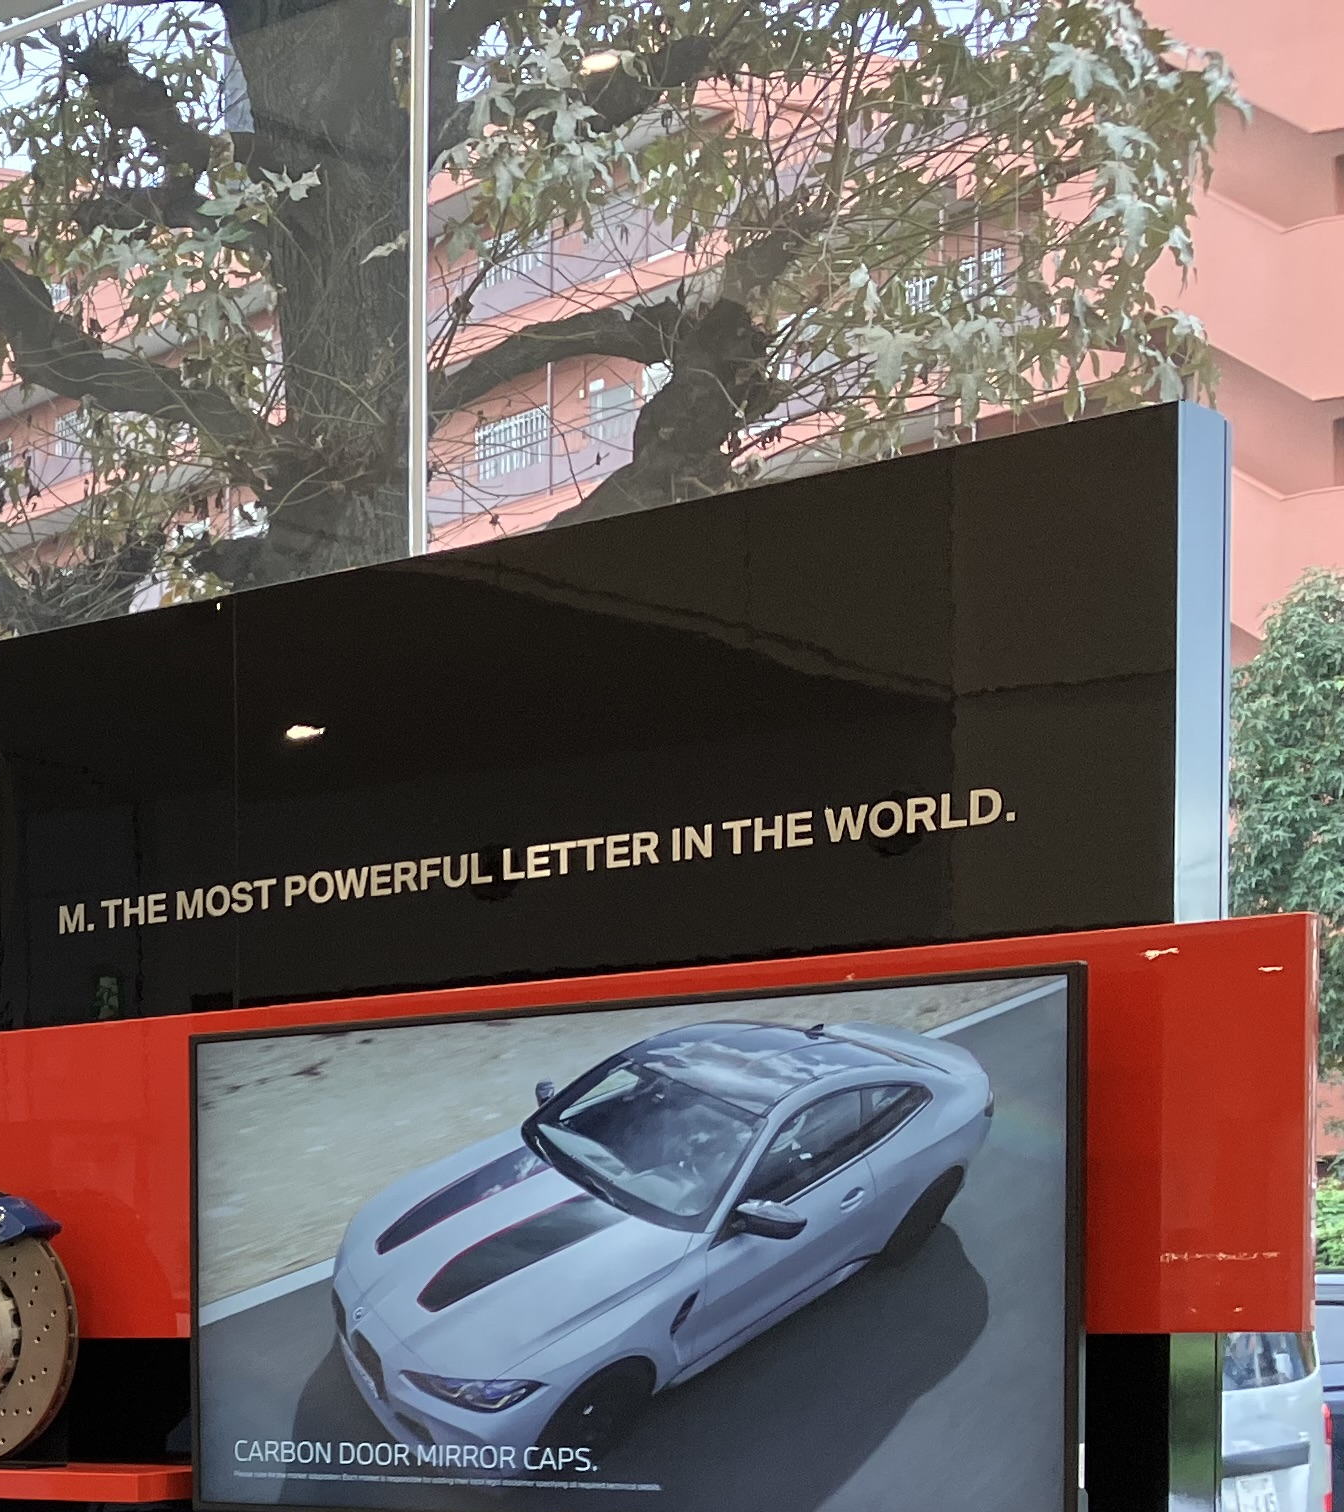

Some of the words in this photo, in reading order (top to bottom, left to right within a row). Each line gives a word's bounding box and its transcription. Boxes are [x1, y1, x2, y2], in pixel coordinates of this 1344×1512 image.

[57, 902, 96, 935] M.
[100, 892, 169, 929] THE
[175, 877, 278, 921] MOST
[284, 851, 494, 907] POWERFUL
[502, 830, 661, 881] LETTER
[670, 822, 713, 862] IN
[721, 810, 814, 855] THE
[823, 786, 1017, 843] WORLD.
[233, 1438, 332, 1464] CARBON
[339, 1441, 411, 1467] DOOR
[417, 1444, 517, 1470] MIRROR
[523, 1446, 600, 1473] CAPS.
